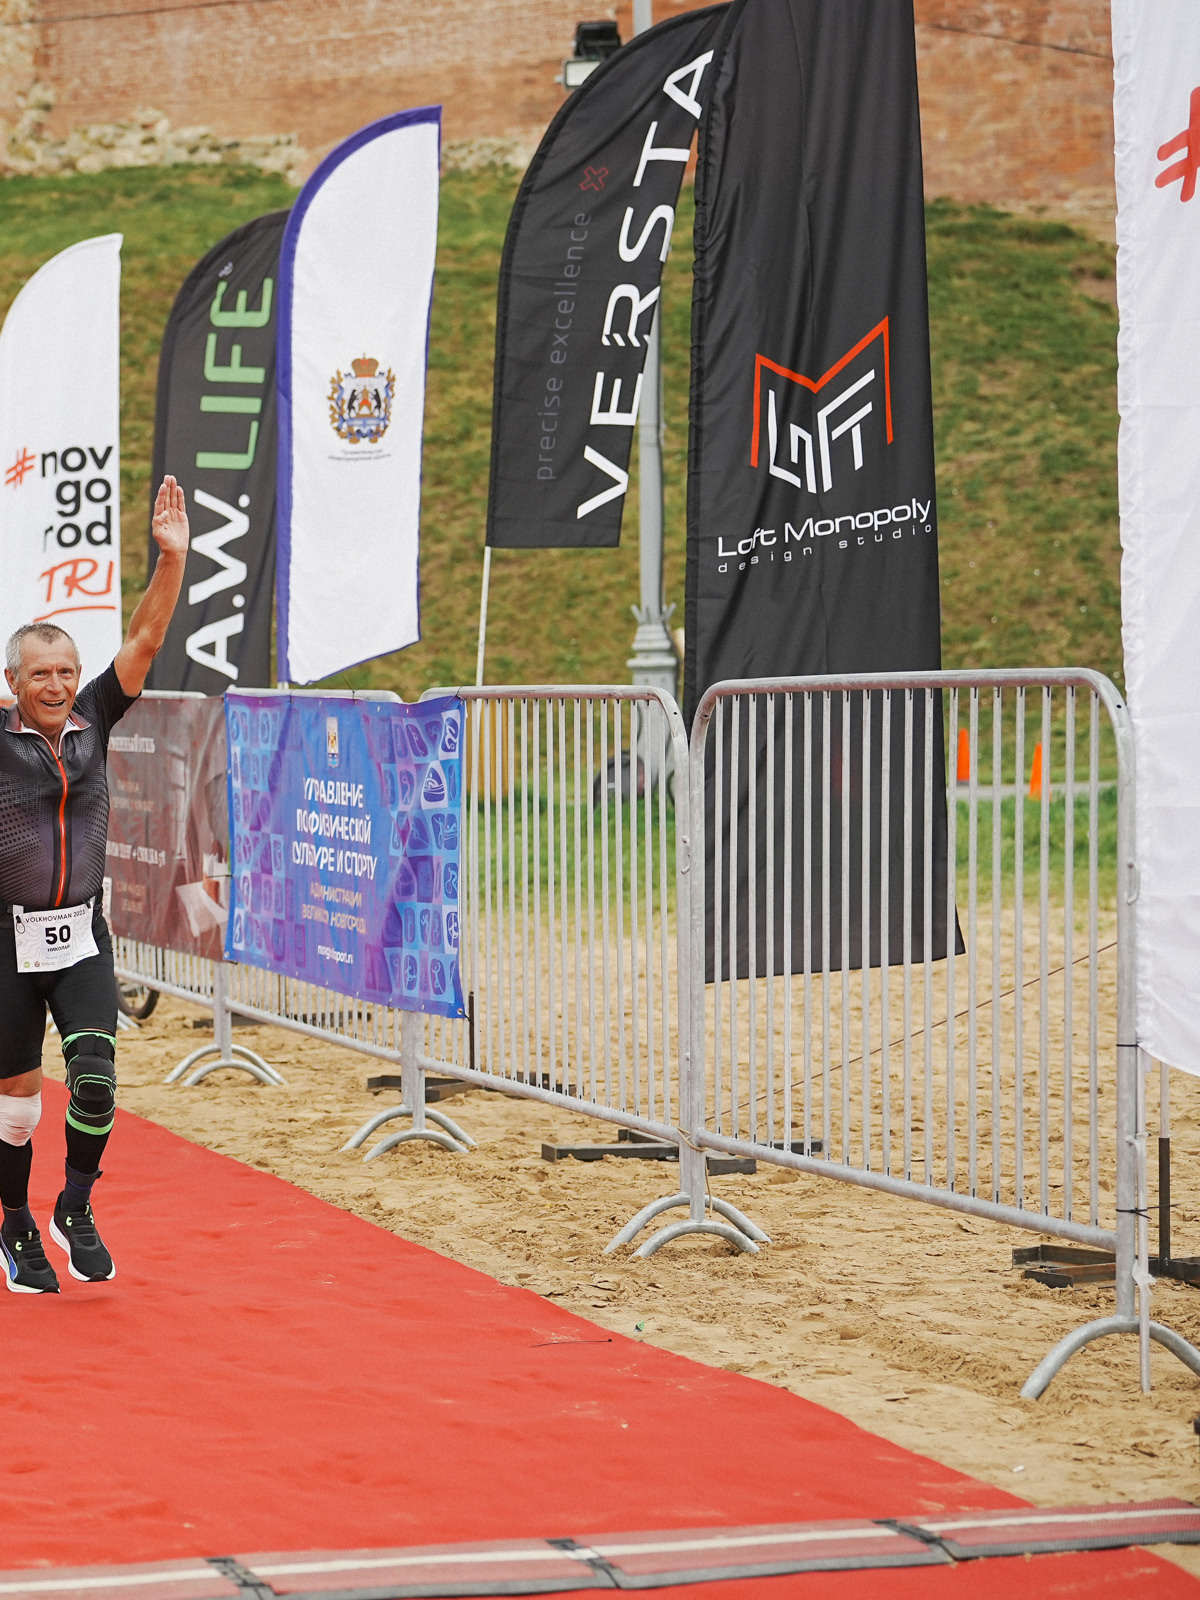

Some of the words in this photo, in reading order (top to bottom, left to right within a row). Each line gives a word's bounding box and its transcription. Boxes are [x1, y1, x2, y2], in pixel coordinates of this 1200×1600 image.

[577, 49, 714, 519] VERSTA
[537, 377, 563, 480] precise
[550, 212, 592, 364] excellence
[196, 277, 274, 470] LIFE
[55, 478, 112, 517] go
[717, 527, 777, 557] Loft
[784, 497, 932, 543] Monopoly
[717, 545, 813, 573] design
[838, 523, 933, 549] studio
[38, 558, 114, 602] TRI
[25, 912, 72, 923] VOLKHOVMAN
[73, 909, 86, 917] 2023
[45, 924, 71, 945] 50
[47, 944, 71, 952] НИКОЛАЙ
